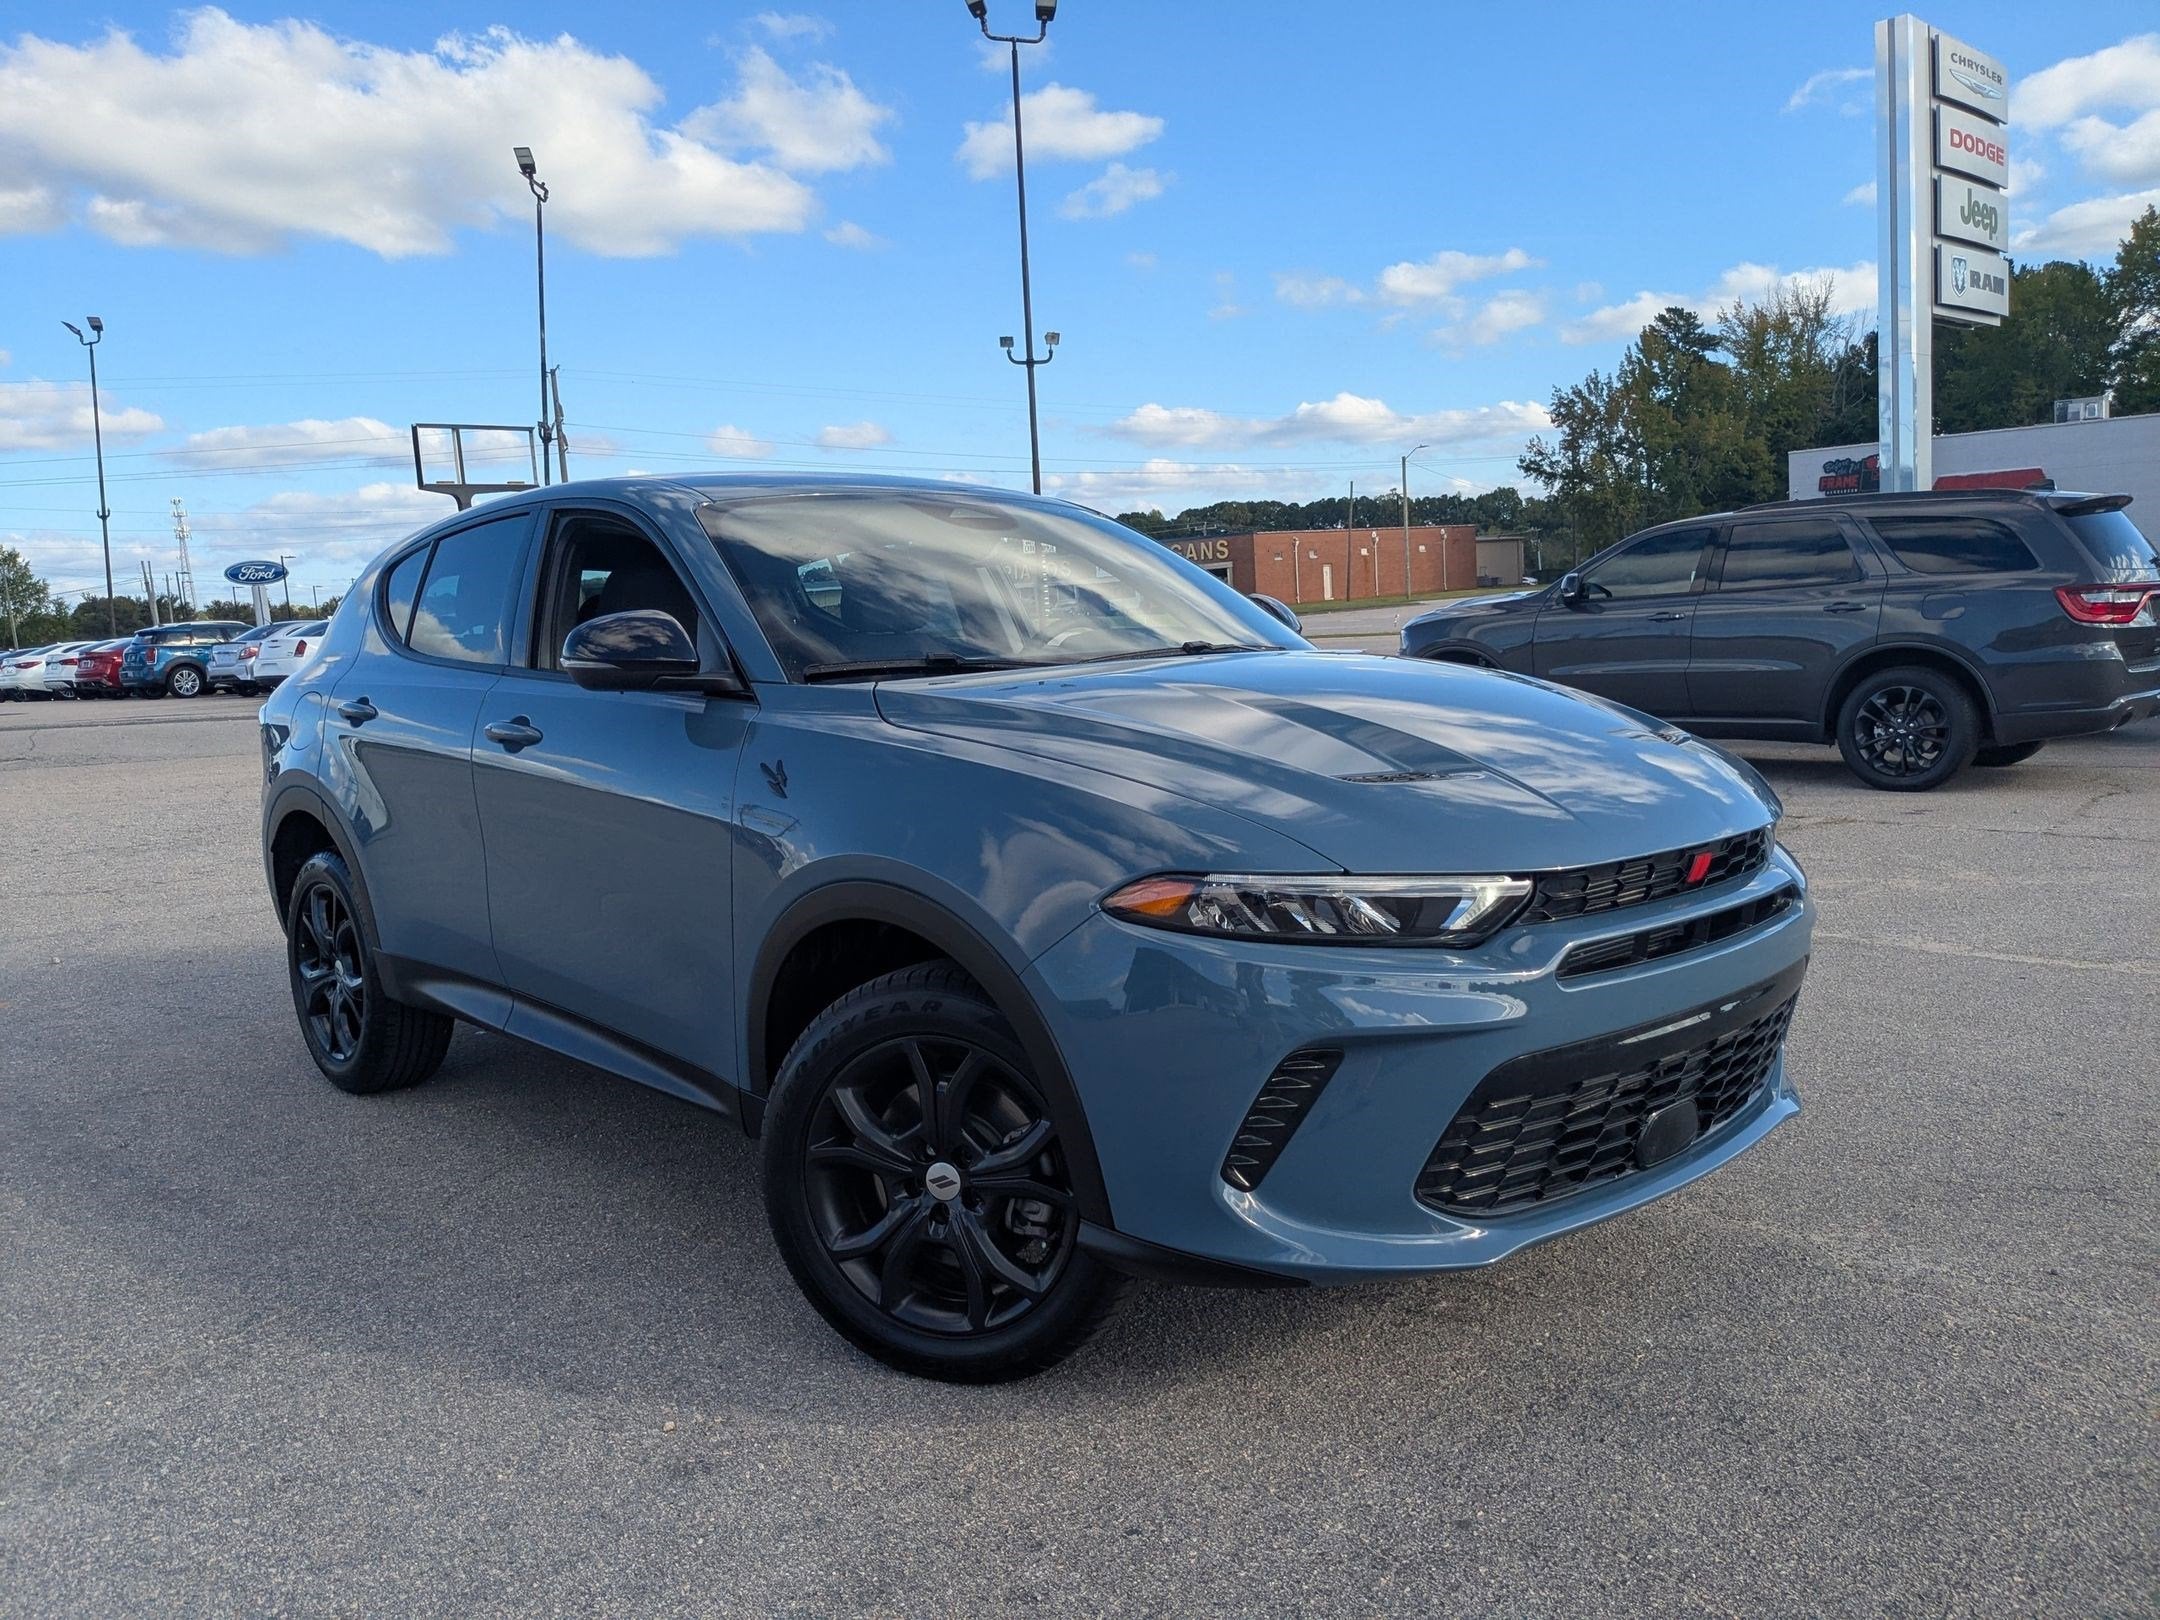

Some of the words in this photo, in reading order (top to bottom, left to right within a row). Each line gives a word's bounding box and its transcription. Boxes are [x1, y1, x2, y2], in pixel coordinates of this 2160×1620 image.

[1950, 53, 2002, 85] CHRYSLER
[1950, 128, 2004, 166] DODGE
[1960, 188, 1998, 240] Jeep
[1969, 269, 2004, 296] RAM
[1821, 475, 1858, 489] FRAME
[239, 565, 275, 580] Ford
